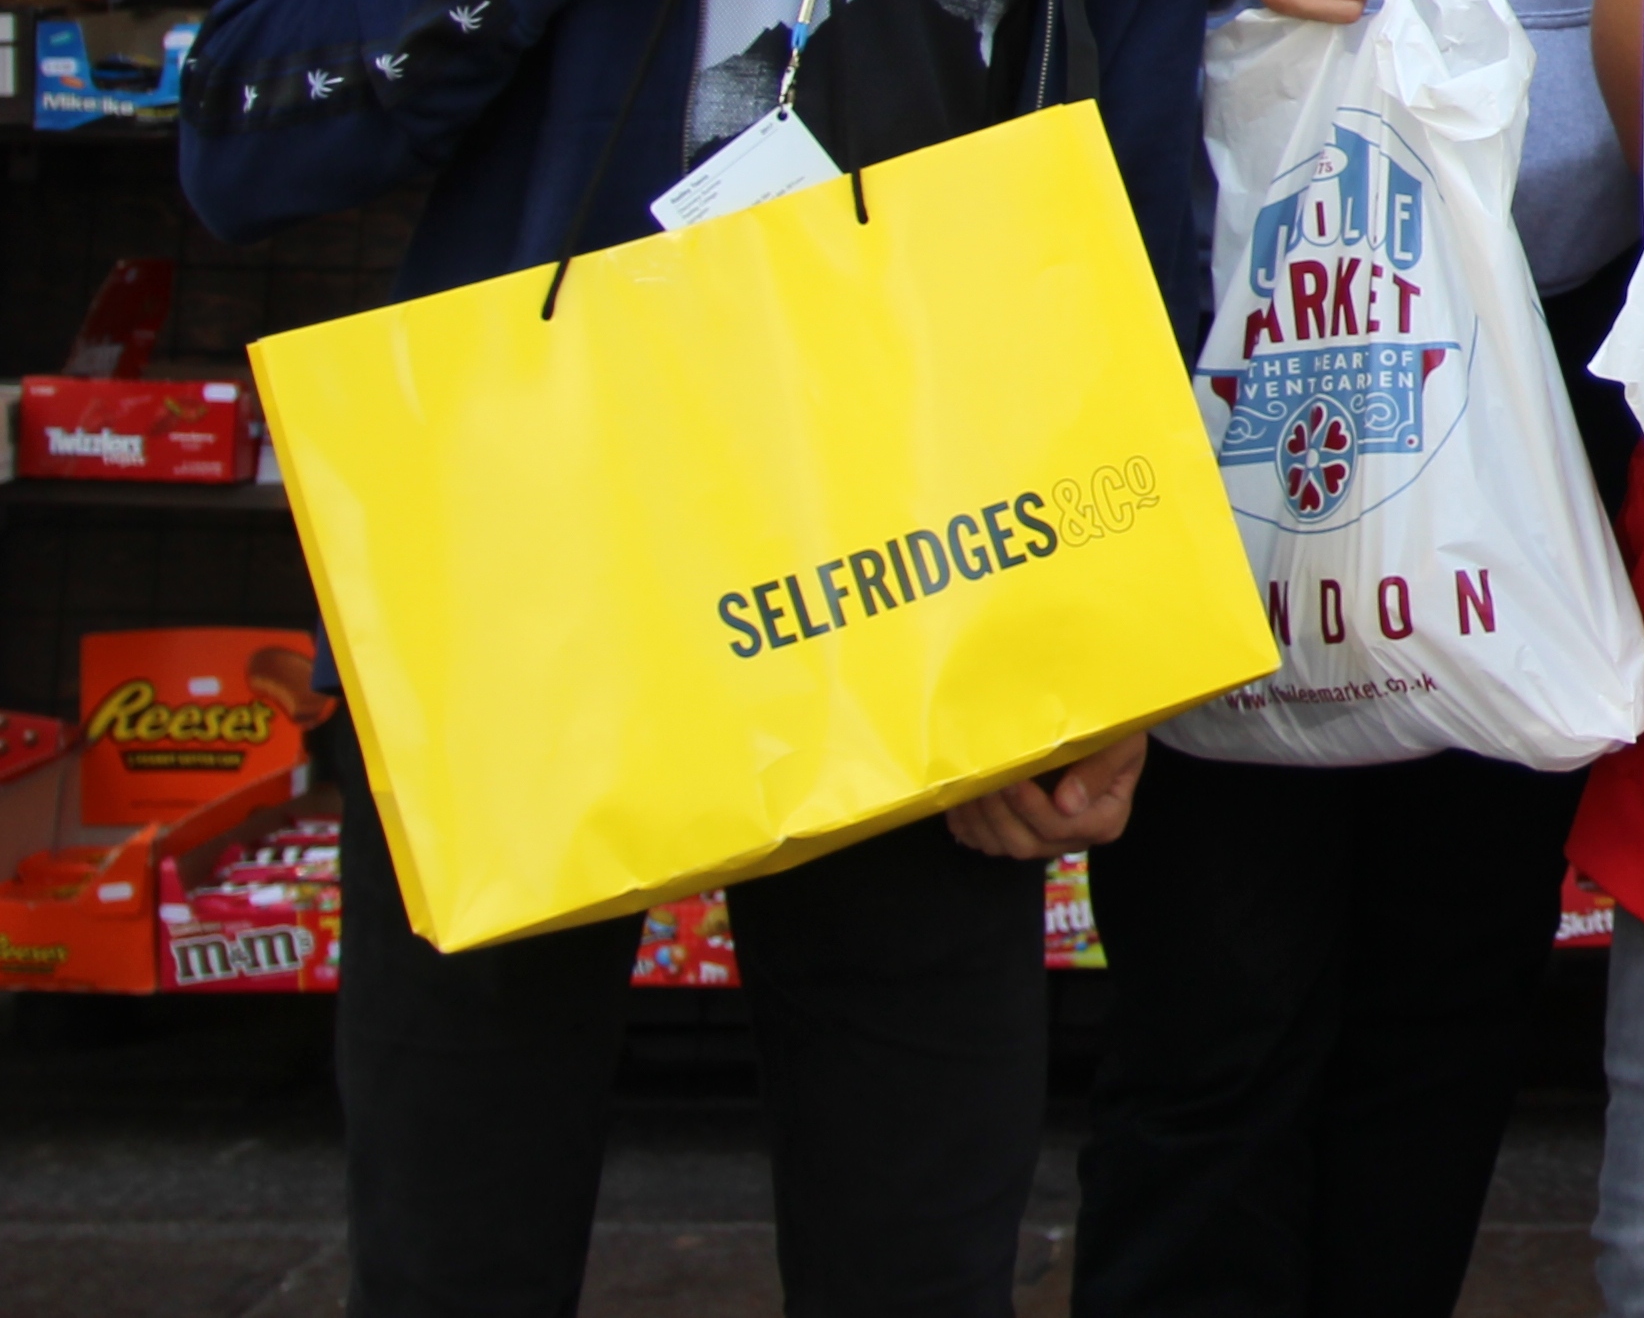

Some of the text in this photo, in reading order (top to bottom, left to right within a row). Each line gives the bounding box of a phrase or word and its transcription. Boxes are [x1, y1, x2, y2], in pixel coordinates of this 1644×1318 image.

[42, 91, 134, 116] Mike Ike
[1314, 352, 1370, 371] HEAR
[1379, 348, 1414, 367] OF
[45, 426, 144, 457] Twizzlers
[1267, 568, 1497, 647] NDON
[1555, 907, 1615, 941] Skitt
